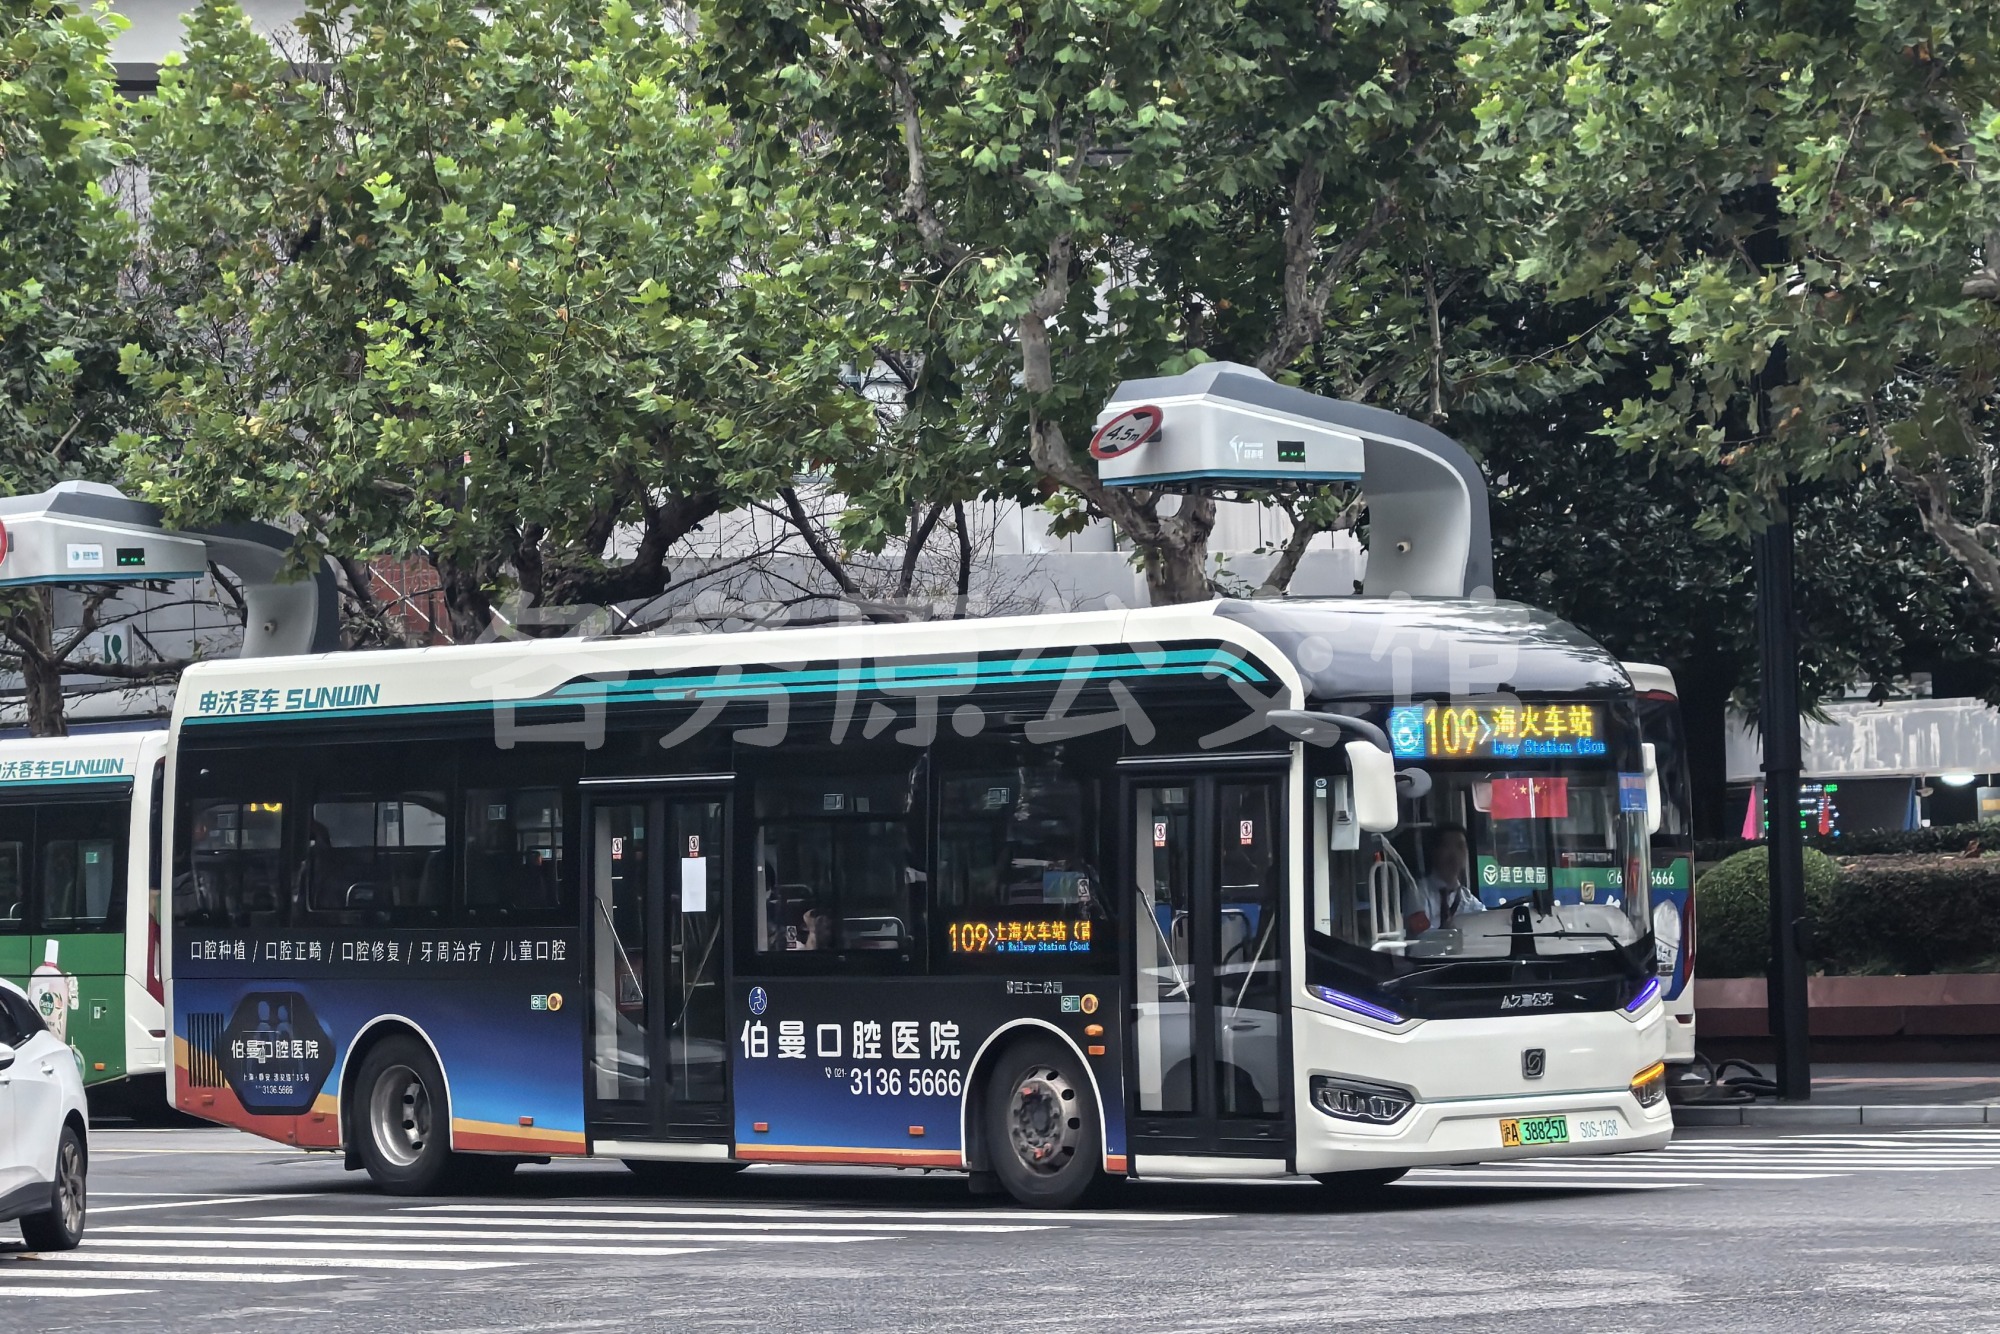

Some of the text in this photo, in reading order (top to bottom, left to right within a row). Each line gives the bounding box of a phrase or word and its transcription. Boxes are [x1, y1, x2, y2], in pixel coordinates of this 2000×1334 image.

[1106, 424, 1140, 442] 4.5m
[199, 684, 380, 714] 申沃客车 SUNWIN
[1425, 708, 1478, 755] 109
[0, 758, 124, 779] 沃客车 SUNWIN
[949, 922, 989, 952] 109
[1039, 941, 1067, 951] Station
[191, 940, 246, 961] 口腔种植
[265, 941, 322, 961] 口腔正畸
[341, 941, 400, 963] 口腔修复
[420, 940, 482, 963] 牙周治疗
[503, 939, 567, 962] 儿童口腔
[231, 1039, 319, 1060] 伯曼口腔医院
[740, 1020, 962, 1060] 伯曼口腔医院
[850, 1068, 902, 1096] 3136
[908, 1068, 962, 1097] 5666
